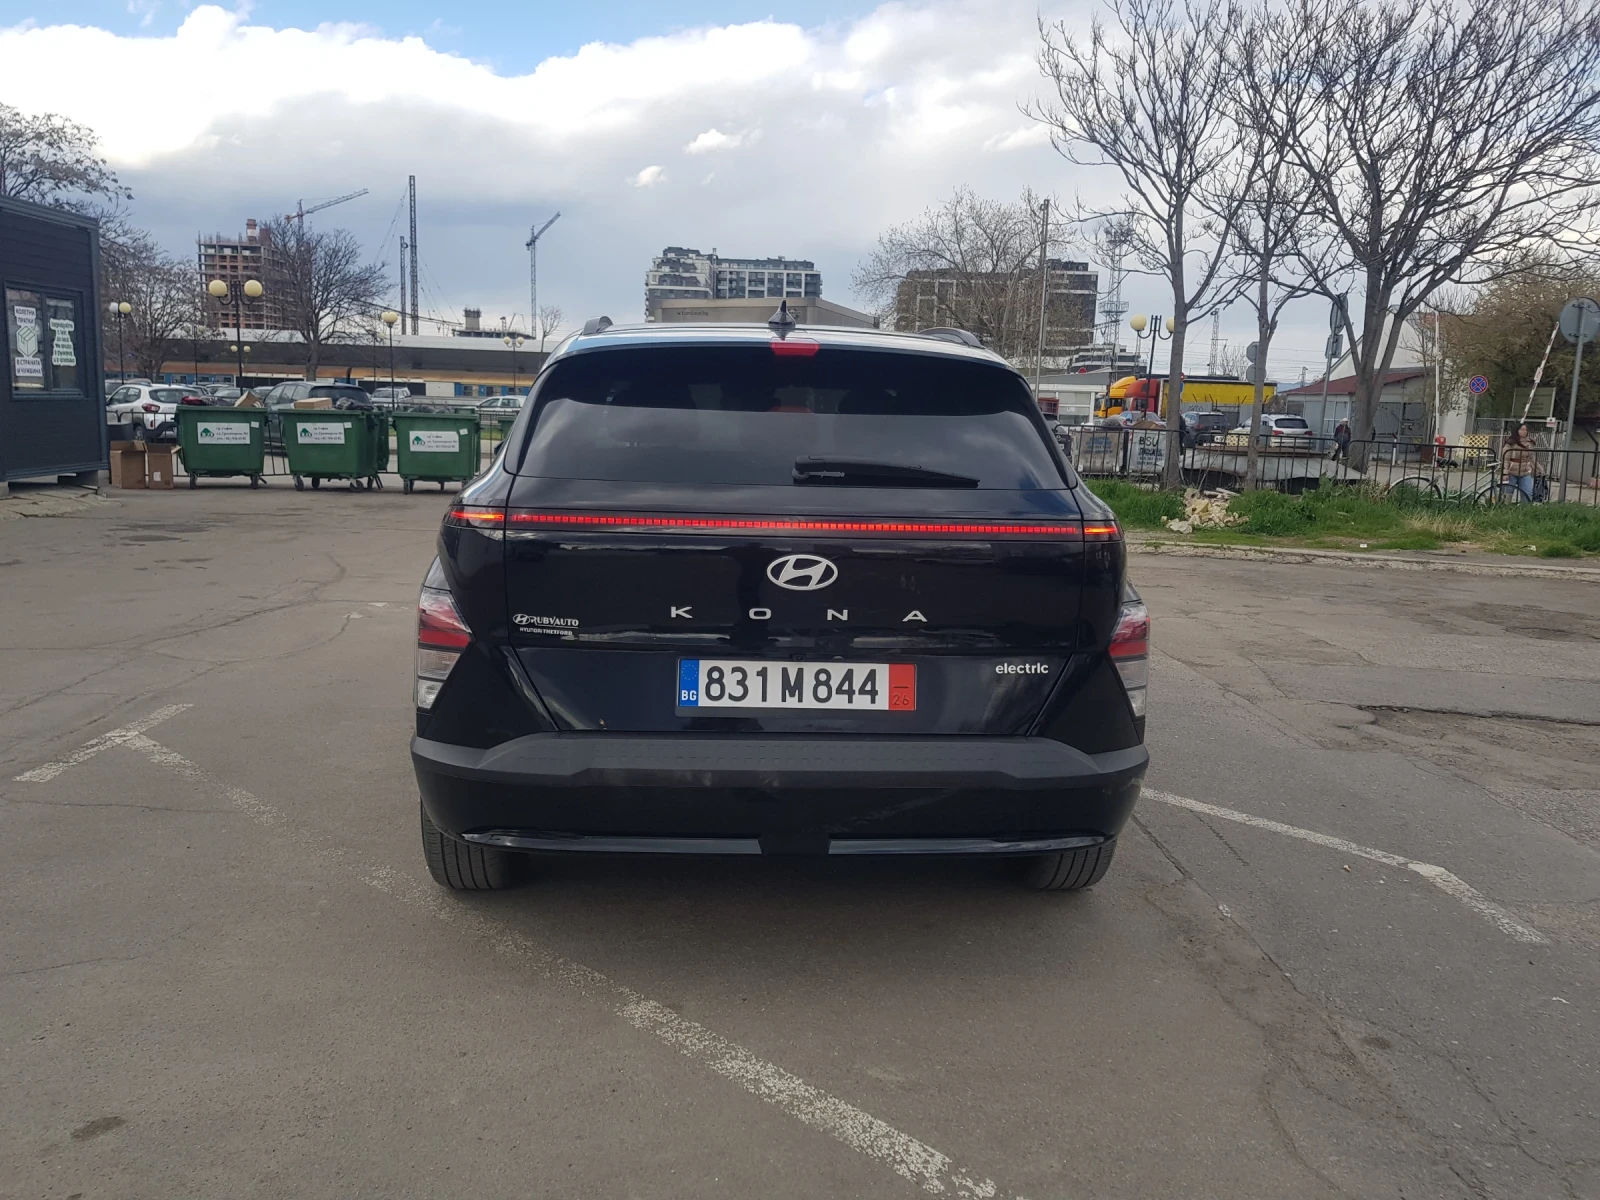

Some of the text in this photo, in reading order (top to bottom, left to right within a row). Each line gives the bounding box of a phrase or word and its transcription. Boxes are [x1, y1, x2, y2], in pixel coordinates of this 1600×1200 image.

[670, 606, 928, 622] KONA
[543, 628, 573, 636] THETFORD
[995, 662, 1049, 674] electric
[681, 689, 697, 701] BG
[892, 694, 910, 706] 26
